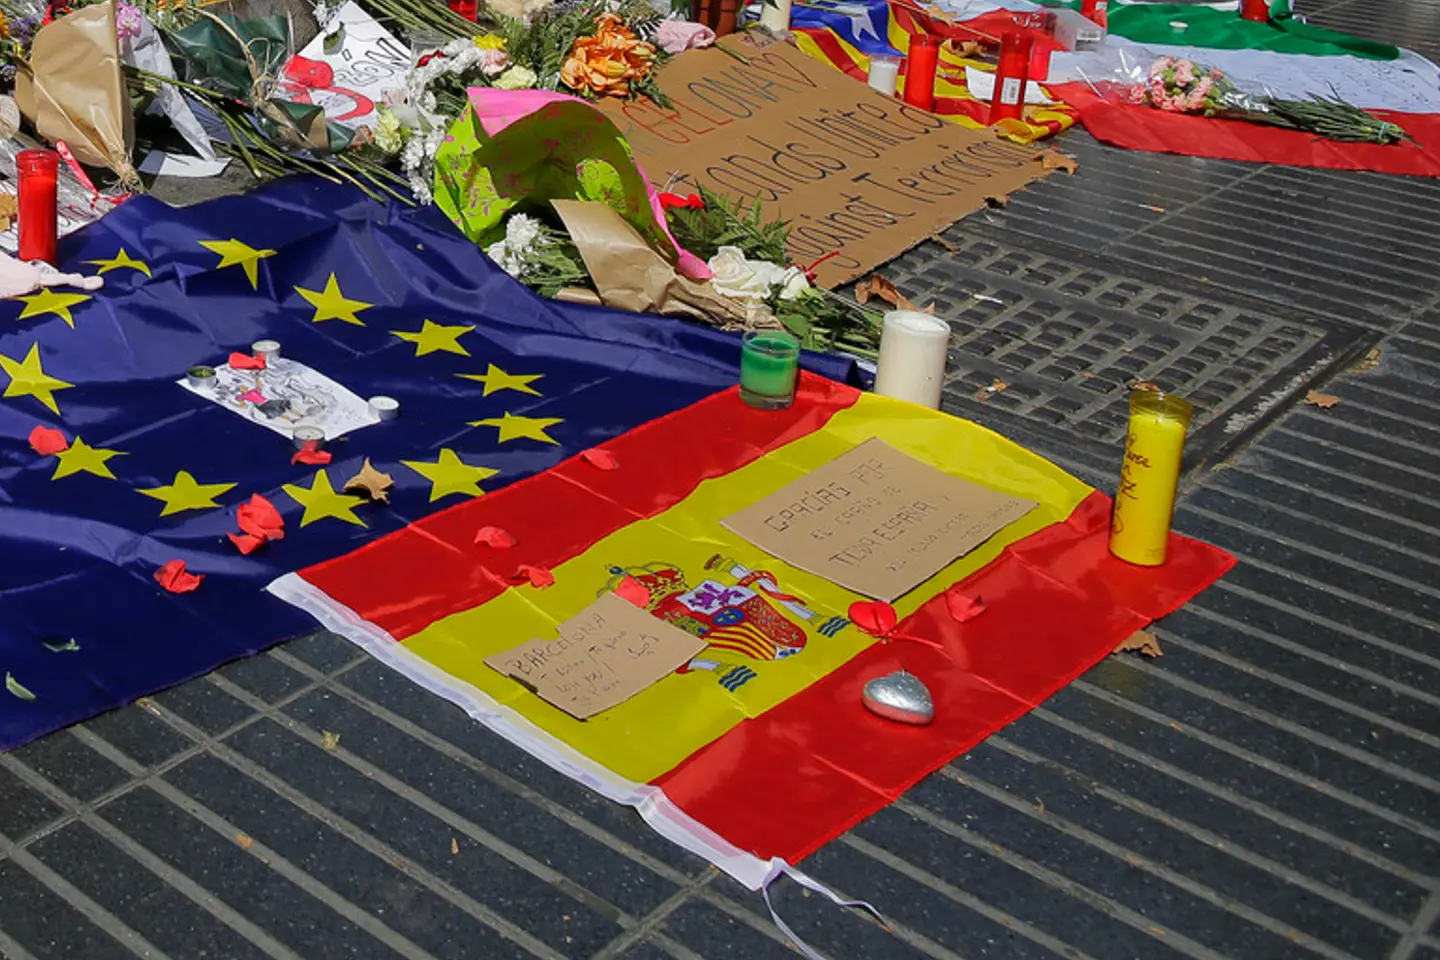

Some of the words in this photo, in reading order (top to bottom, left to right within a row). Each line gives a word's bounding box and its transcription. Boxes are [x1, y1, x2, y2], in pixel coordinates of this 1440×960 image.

[618, 65, 797, 148] CELONA
[655, 134, 847, 208] tands
[784, 102, 944, 159] United
[784, 193, 916, 269] gainst
[850, 140, 1036, 204] Terrorism
[506, 612, 606, 677] BARCELONA
